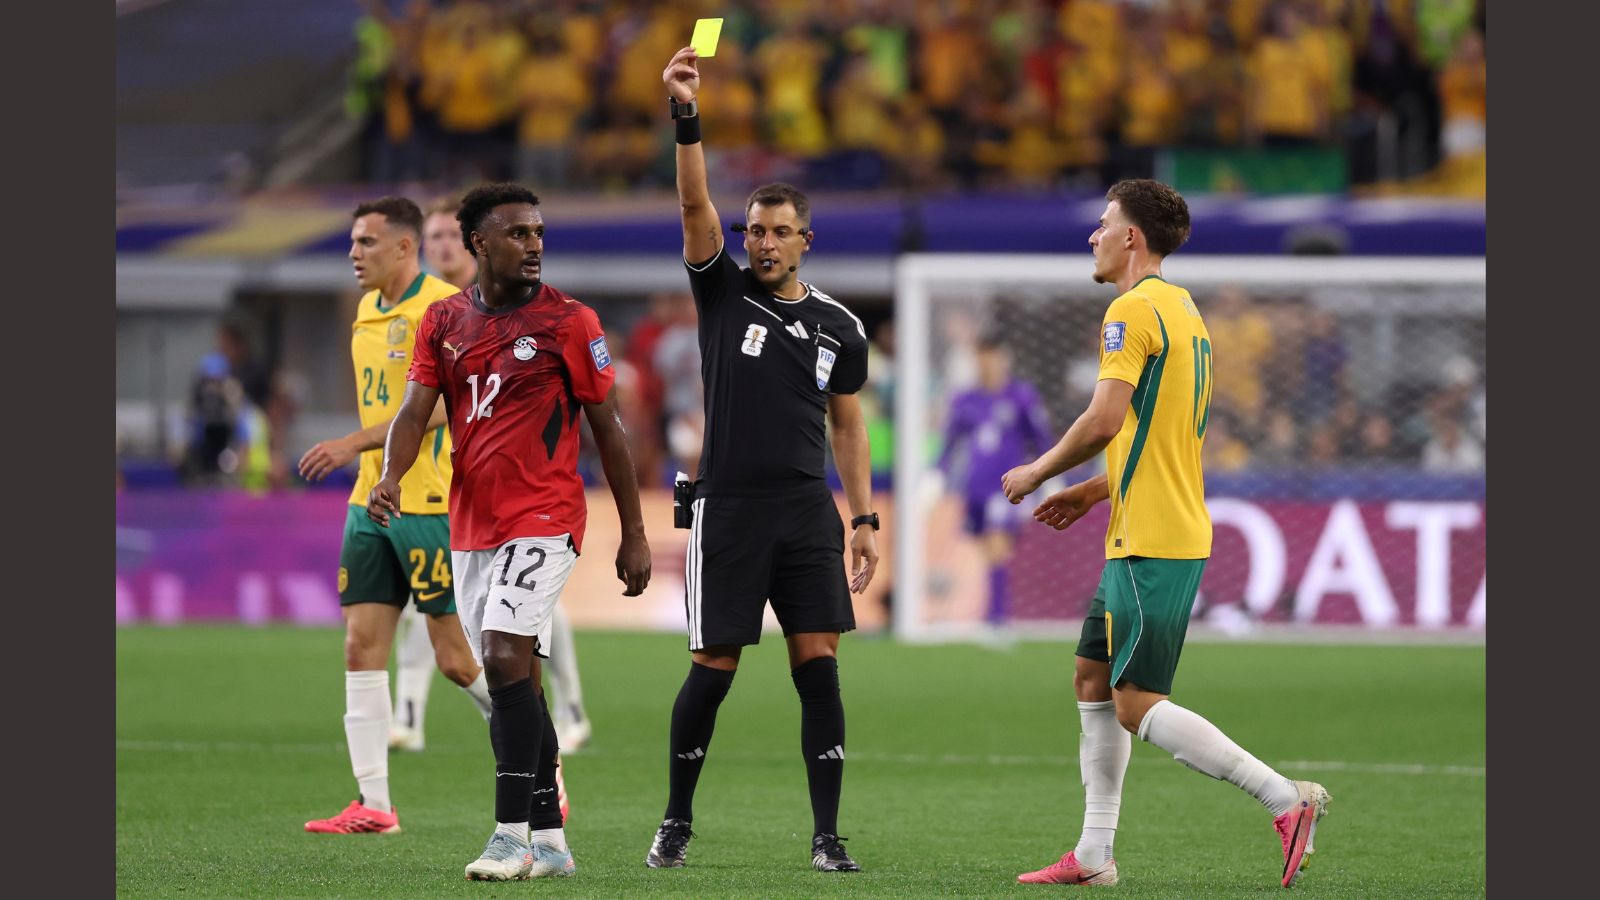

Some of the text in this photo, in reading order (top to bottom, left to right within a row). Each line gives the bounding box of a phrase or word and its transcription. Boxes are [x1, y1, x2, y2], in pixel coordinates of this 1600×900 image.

[363, 367, 389, 407] 24
[466, 373, 502, 424] 12
[1192, 335, 1213, 439] 10
[409, 548, 451, 589] 24
[496, 543, 547, 591] 12
[1192, 499, 1486, 629] QAT
